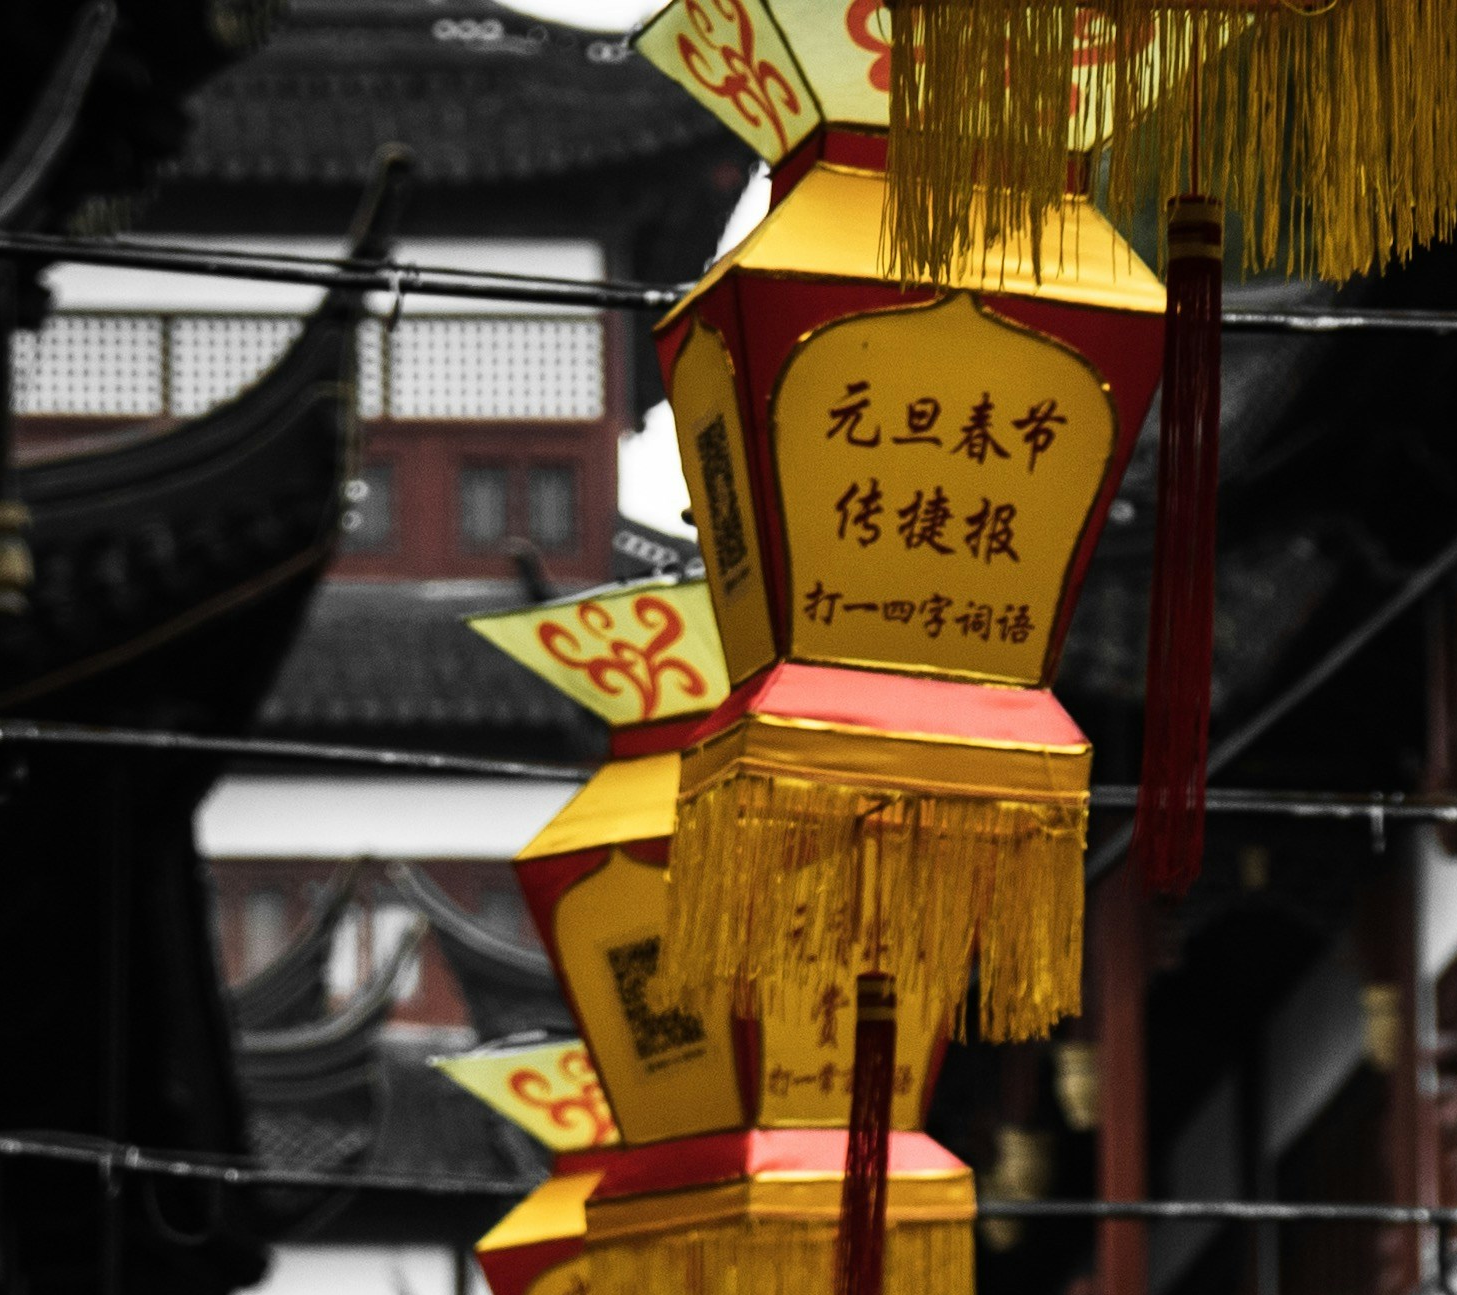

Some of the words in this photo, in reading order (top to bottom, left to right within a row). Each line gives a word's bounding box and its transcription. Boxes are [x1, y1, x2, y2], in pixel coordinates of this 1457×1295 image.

[825, 381, 1068, 474] 元旦春节
[835, 482, 1022, 564] 传捷报
[801, 580, 1036, 644] 打一四字词语
